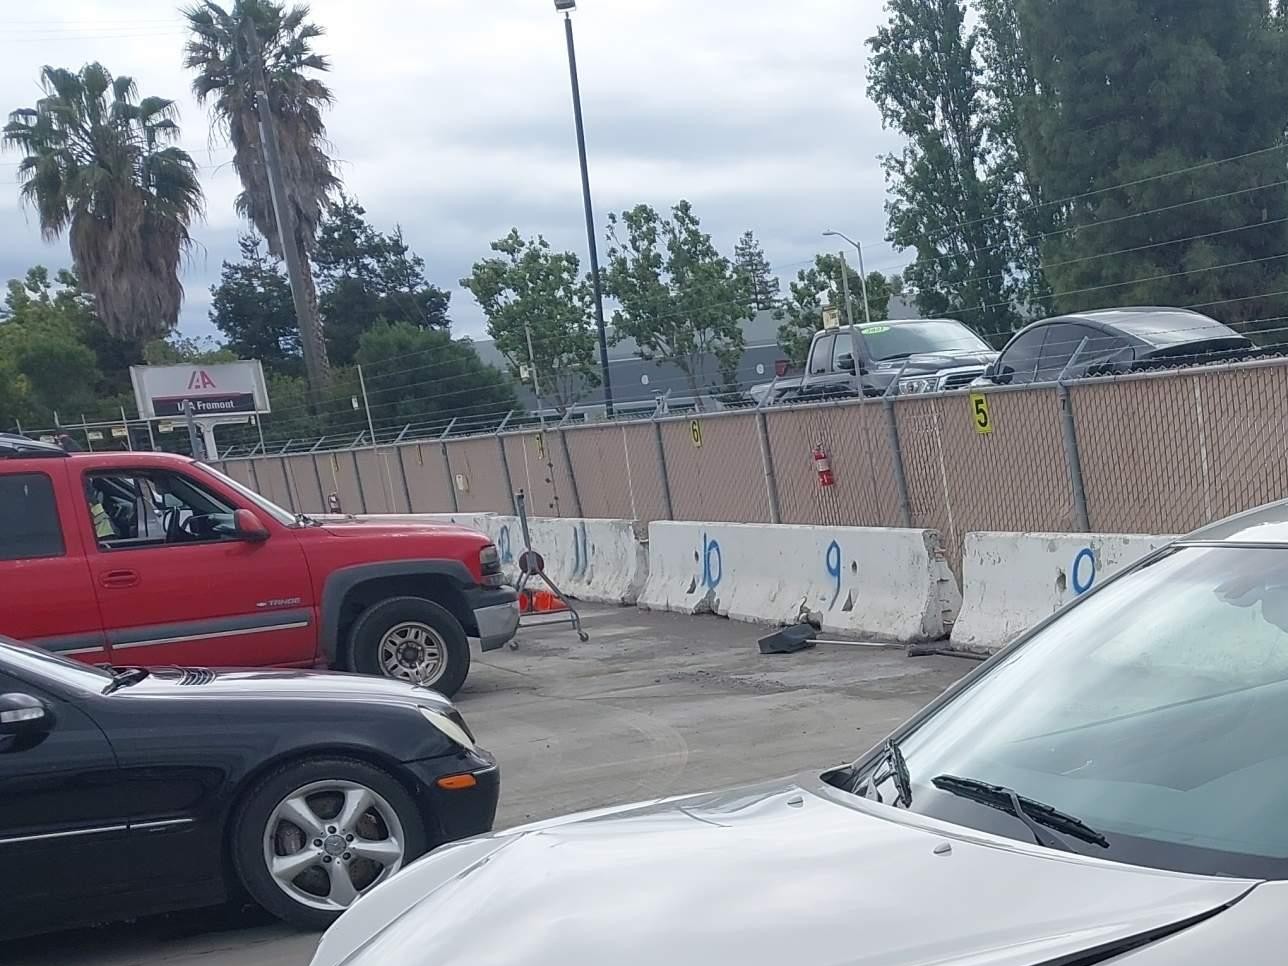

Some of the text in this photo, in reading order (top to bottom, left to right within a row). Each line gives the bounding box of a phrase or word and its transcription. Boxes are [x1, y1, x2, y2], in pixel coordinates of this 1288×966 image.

[197, 400, 236, 410] Fremont
[974, 398, 988, 428] 5
[691, 420, 699, 443] 6
[825, 539, 841, 612] 9
